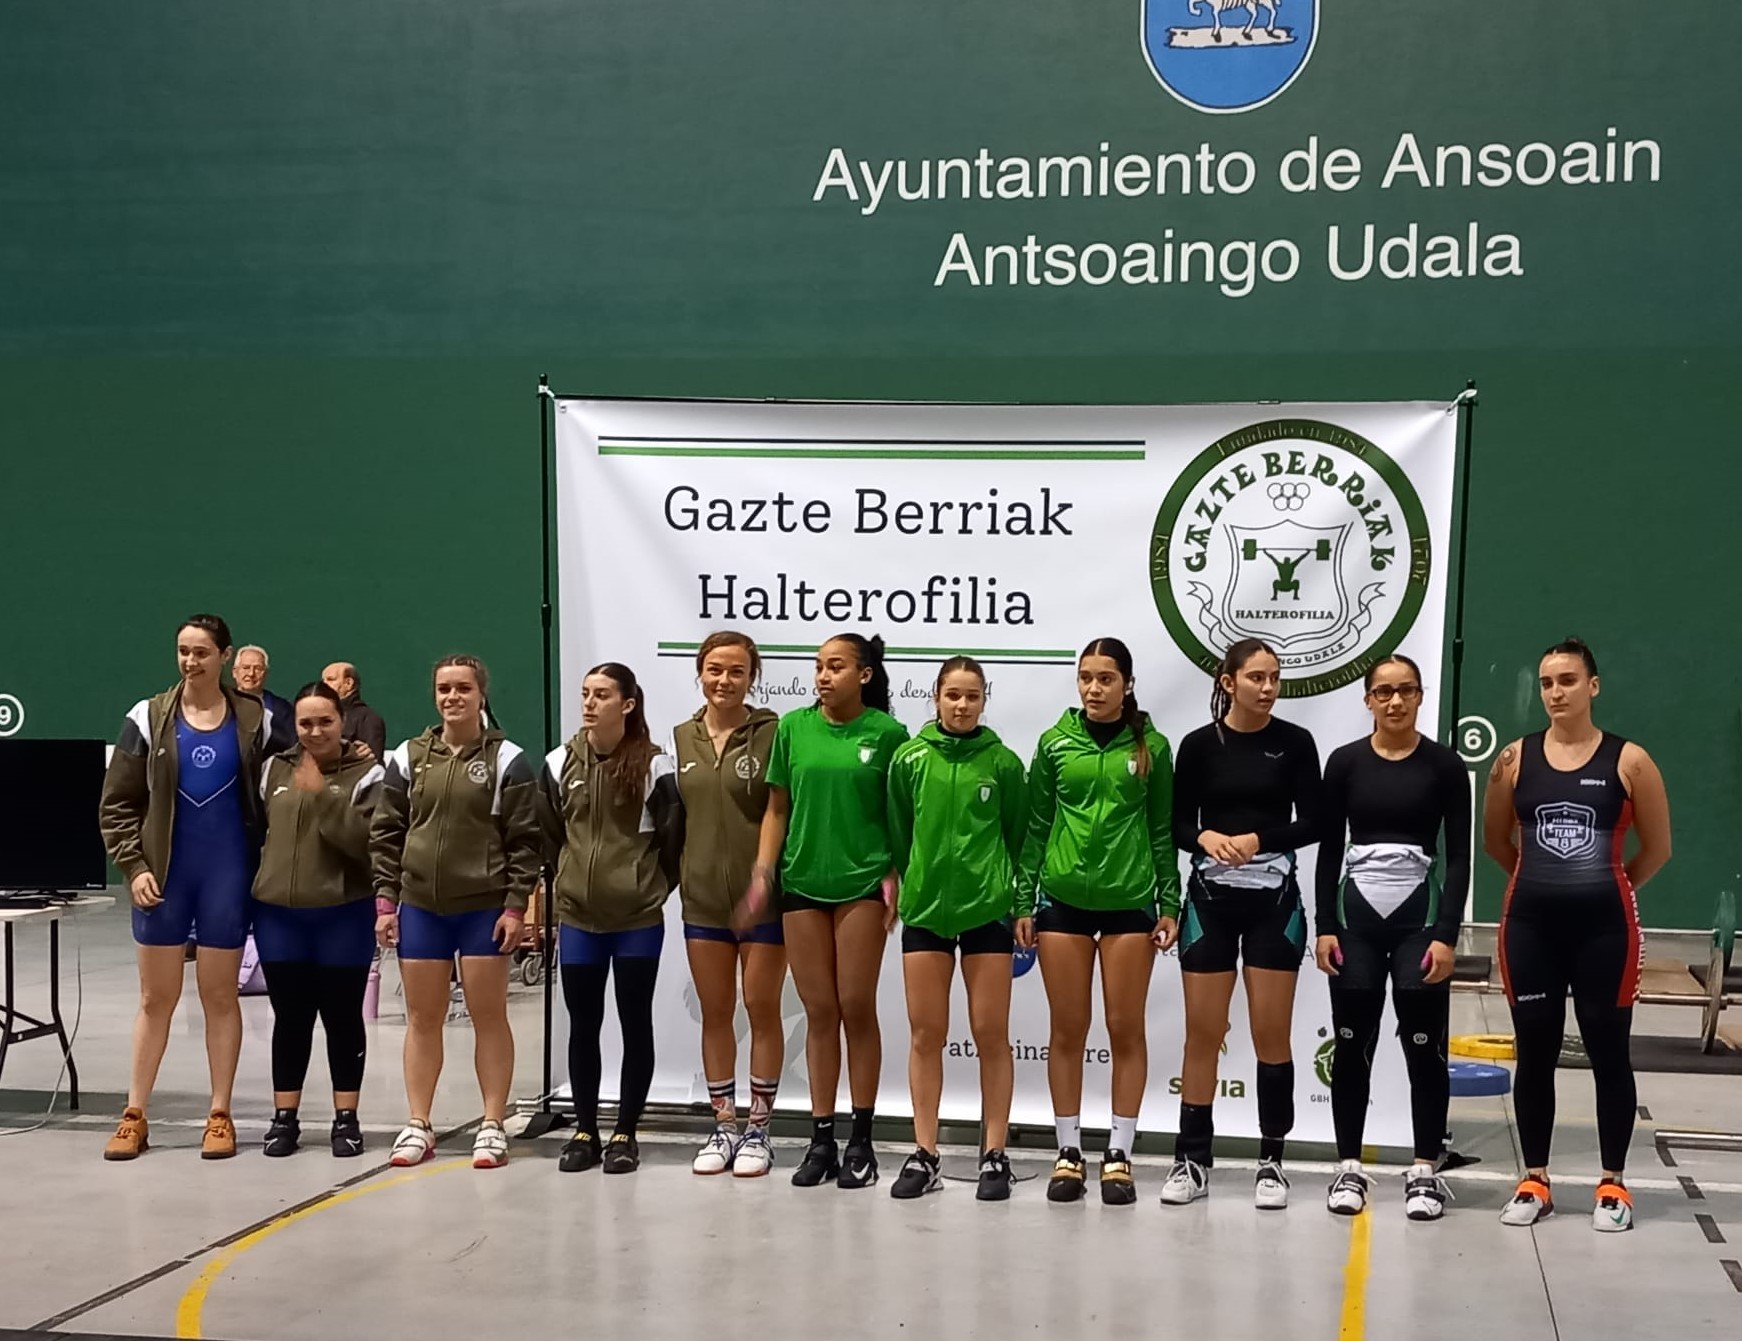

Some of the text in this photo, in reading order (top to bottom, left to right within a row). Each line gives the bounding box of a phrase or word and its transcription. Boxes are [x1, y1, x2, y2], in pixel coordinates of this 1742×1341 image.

[813, 127, 1660, 215] Ayuntamiento de Ansoain
[933, 221, 1524, 298] Antsoaingo Udala
[664, 485, 1073, 536] Gazte Berriak
[1183, 463, 1257, 573] GAZTE
[698, 574, 1034, 625] Halterofilia
[1235, 609, 1335, 620] HALTEROFILIA
[0, 705, 12, 725] 9
[1464, 728, 1482, 750] 6
